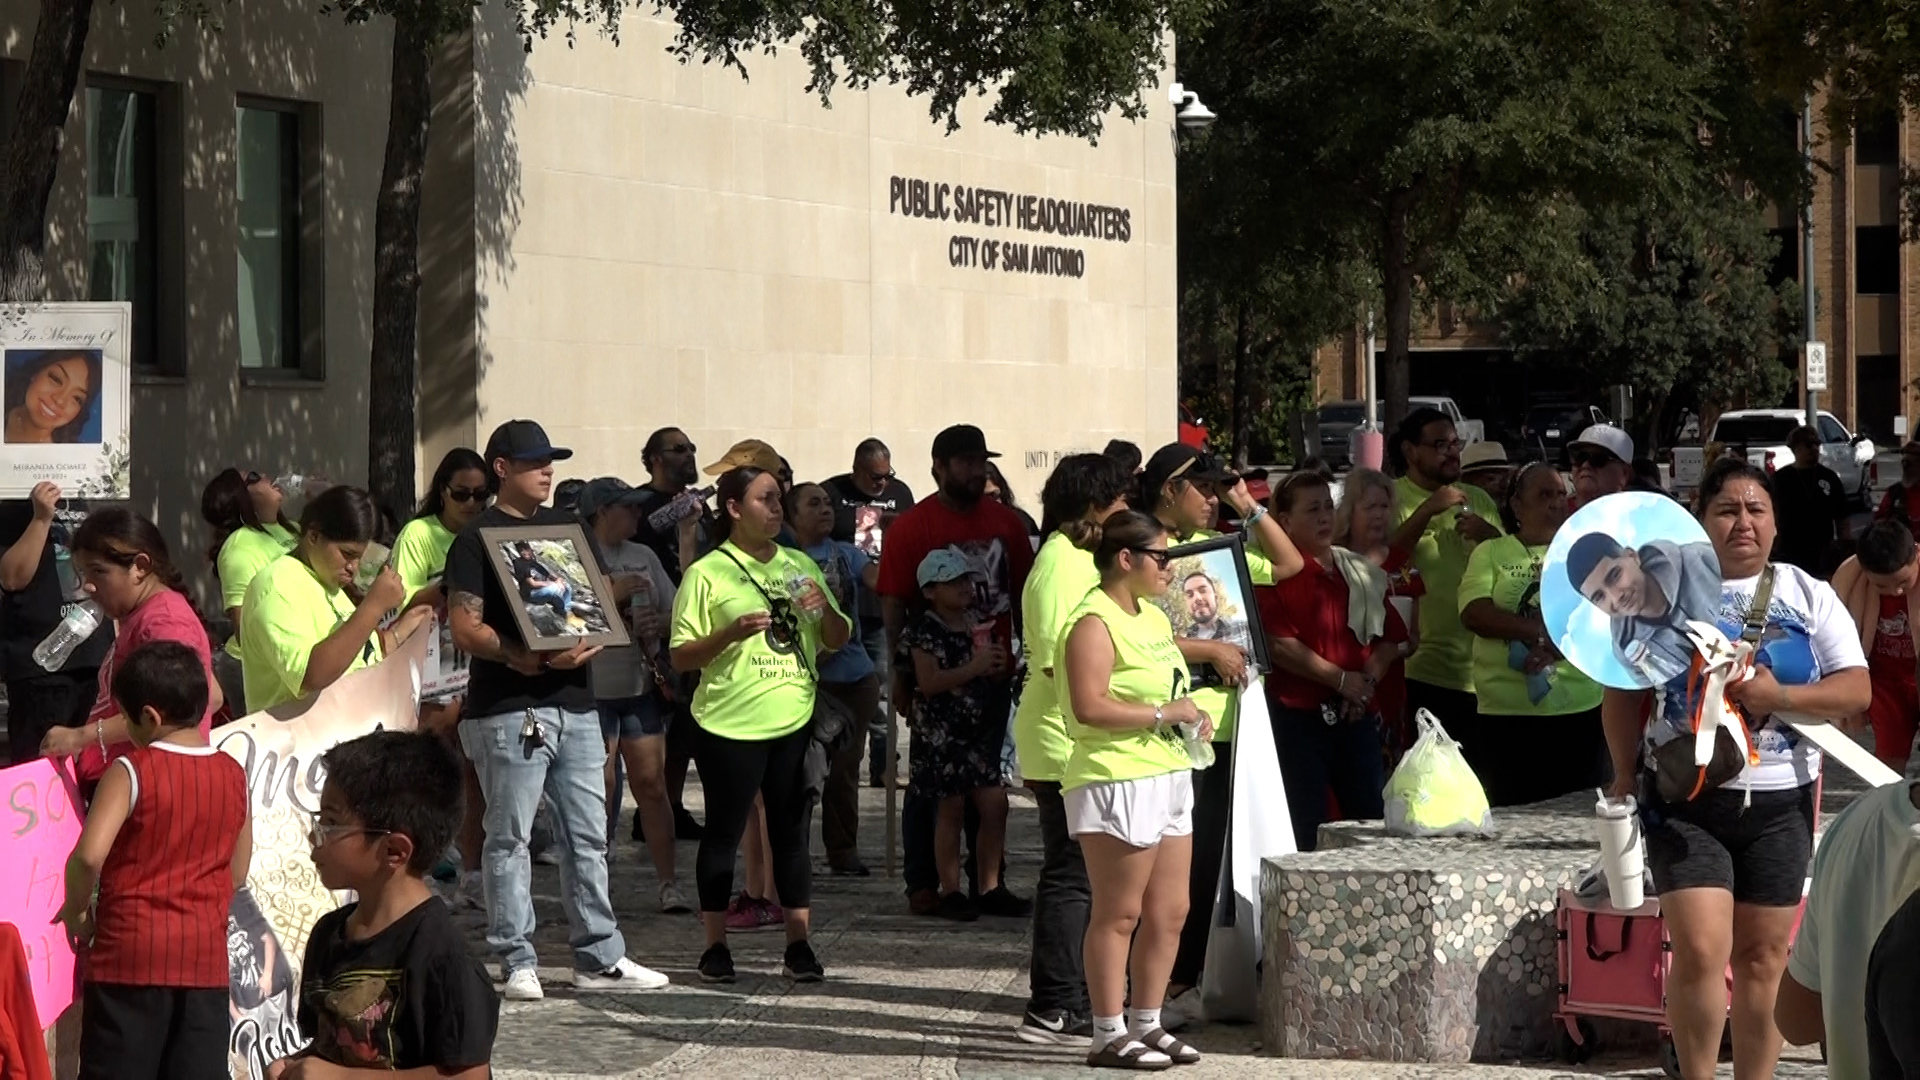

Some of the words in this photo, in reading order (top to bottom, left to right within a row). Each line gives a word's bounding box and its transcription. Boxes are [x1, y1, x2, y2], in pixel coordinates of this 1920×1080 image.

[890, 175, 950, 221] PUBLIC
[954, 185, 1014, 229] SAFETY
[1016, 194, 1131, 243] HEADQUARTERS
[949, 235, 979, 268] CITY
[981, 239, 1000, 271] OF
[1002, 241, 1029, 273] SAN
[1031, 244, 1085, 279] ANTONIO
[42, 326, 97, 346] Memory
[1024, 450, 1049, 469] UNITY
[751, 656, 793, 666] Mothers
[759, 667, 777, 679] For
